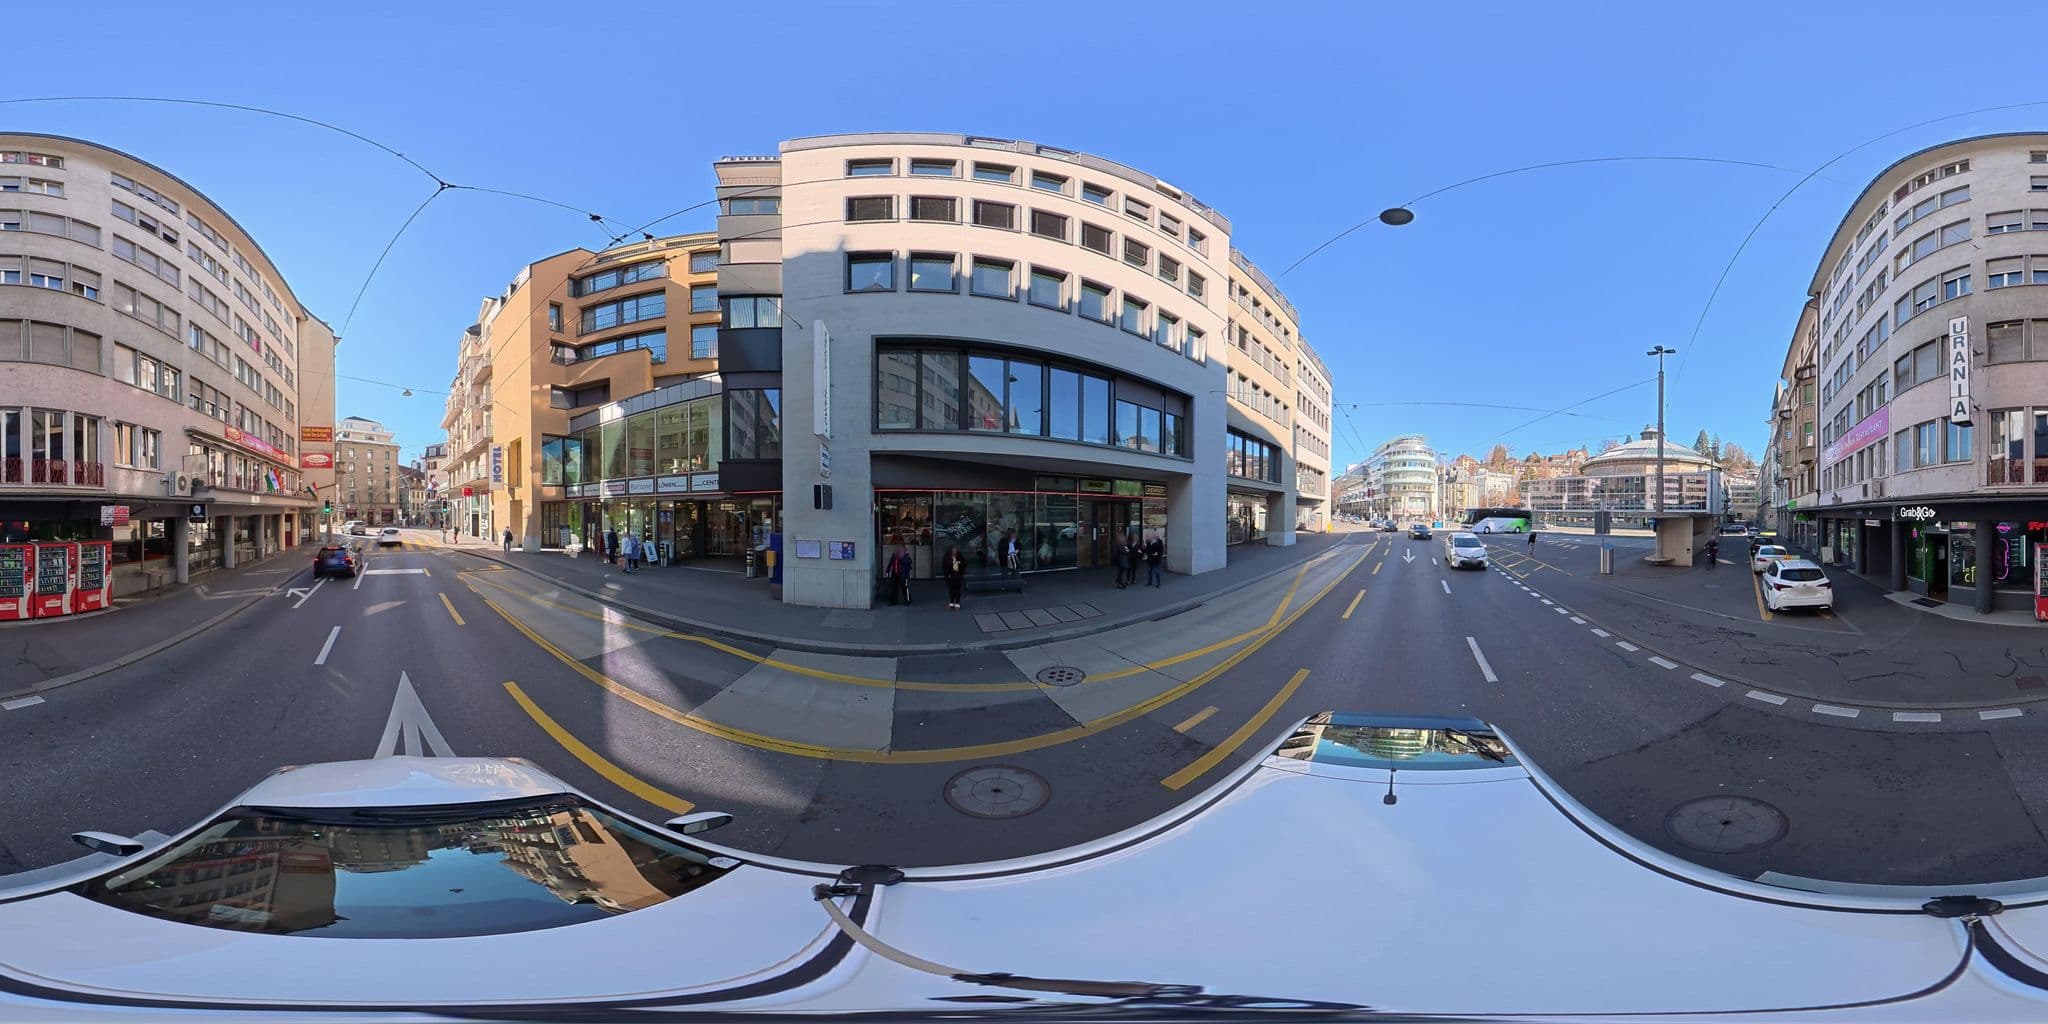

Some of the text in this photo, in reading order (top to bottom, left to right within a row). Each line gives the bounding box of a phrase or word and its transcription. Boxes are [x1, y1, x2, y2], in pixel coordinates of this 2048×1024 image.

[1952, 321, 1967, 416] URANIA
[493, 446, 501, 482] HOTEL
[1900, 506, 1935, 521] Grab&Go
